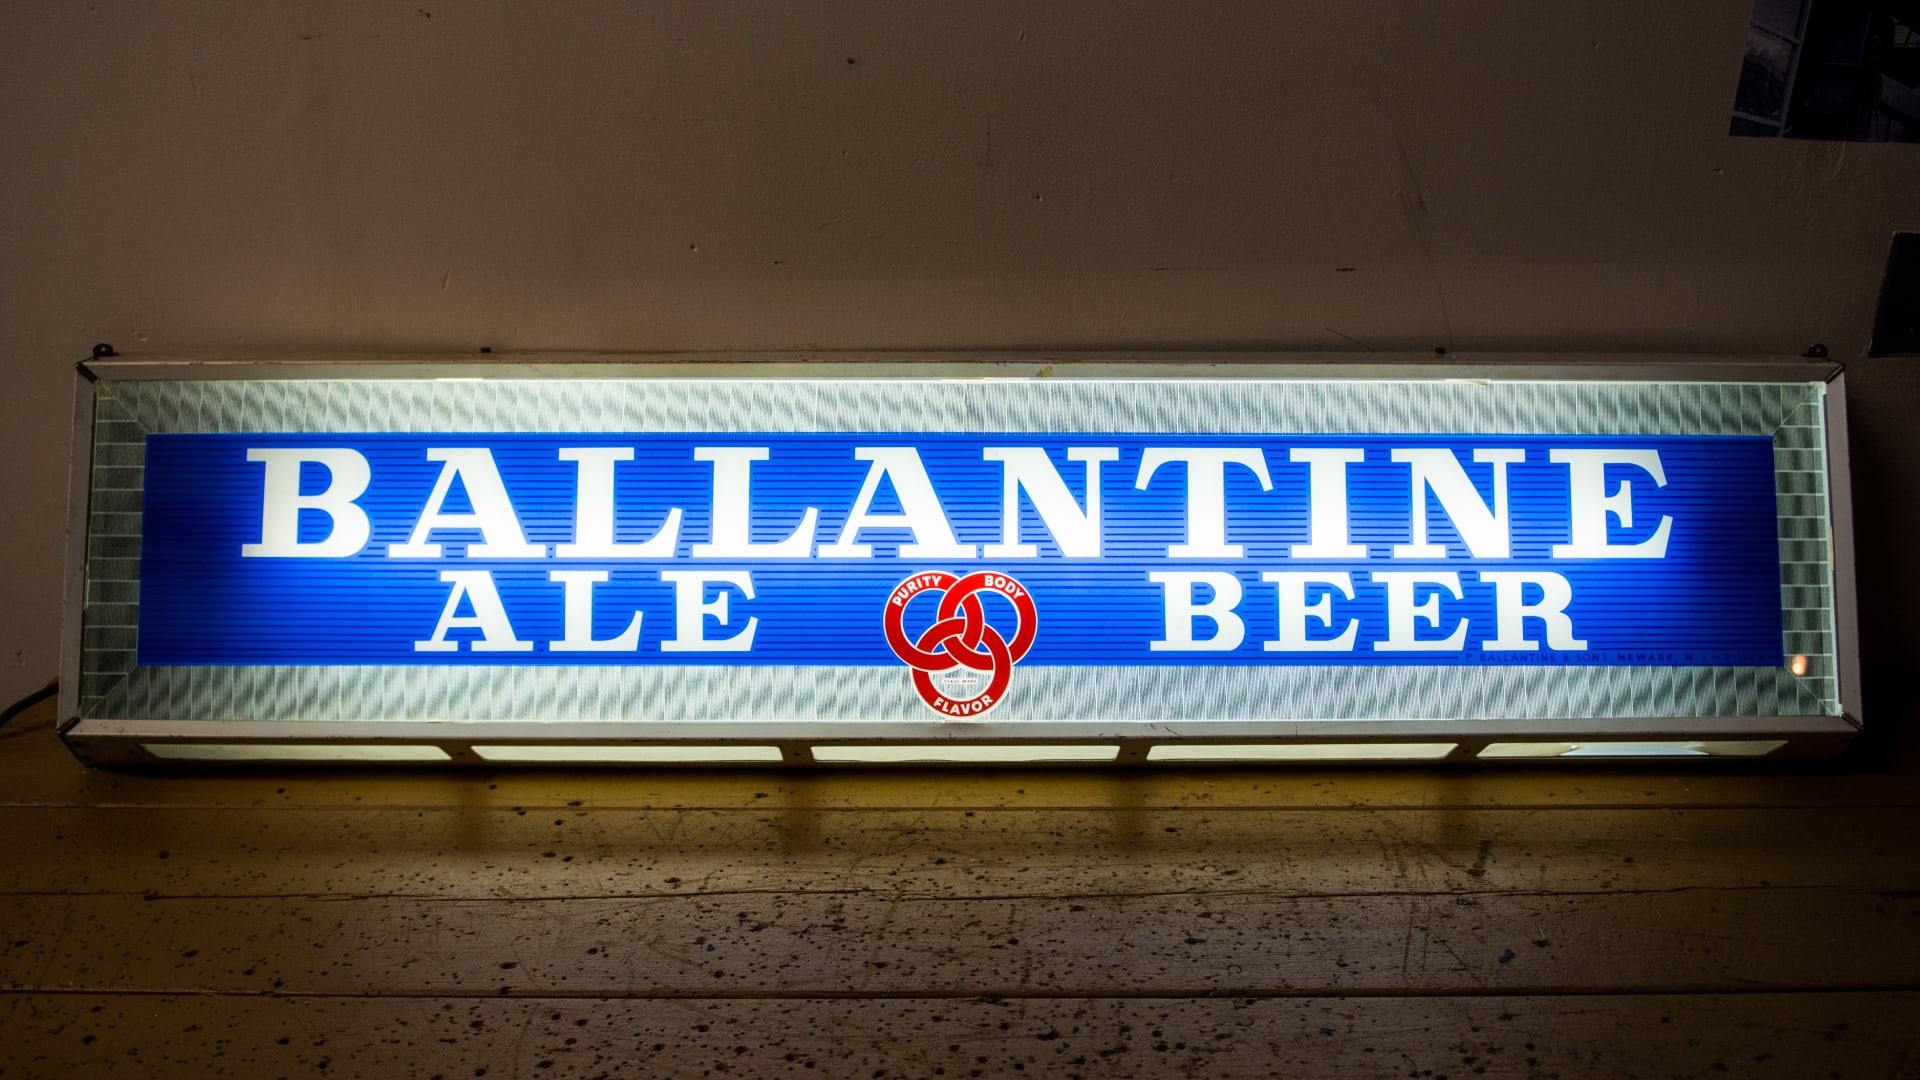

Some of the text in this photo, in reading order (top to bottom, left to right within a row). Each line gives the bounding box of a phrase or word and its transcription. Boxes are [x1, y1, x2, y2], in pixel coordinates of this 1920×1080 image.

[242, 446, 1673, 560] BALLANTINE
[891, 575, 943, 607] PURITY
[984, 575, 1025, 600] BODY
[414, 569, 759, 652] ALE
[1148, 570, 1588, 652] BEER
[1480, 653, 1557, 662] BALLANTINE
[1563, 653, 1571, 662] &
[932, 694, 993, 716] FLAVOR
